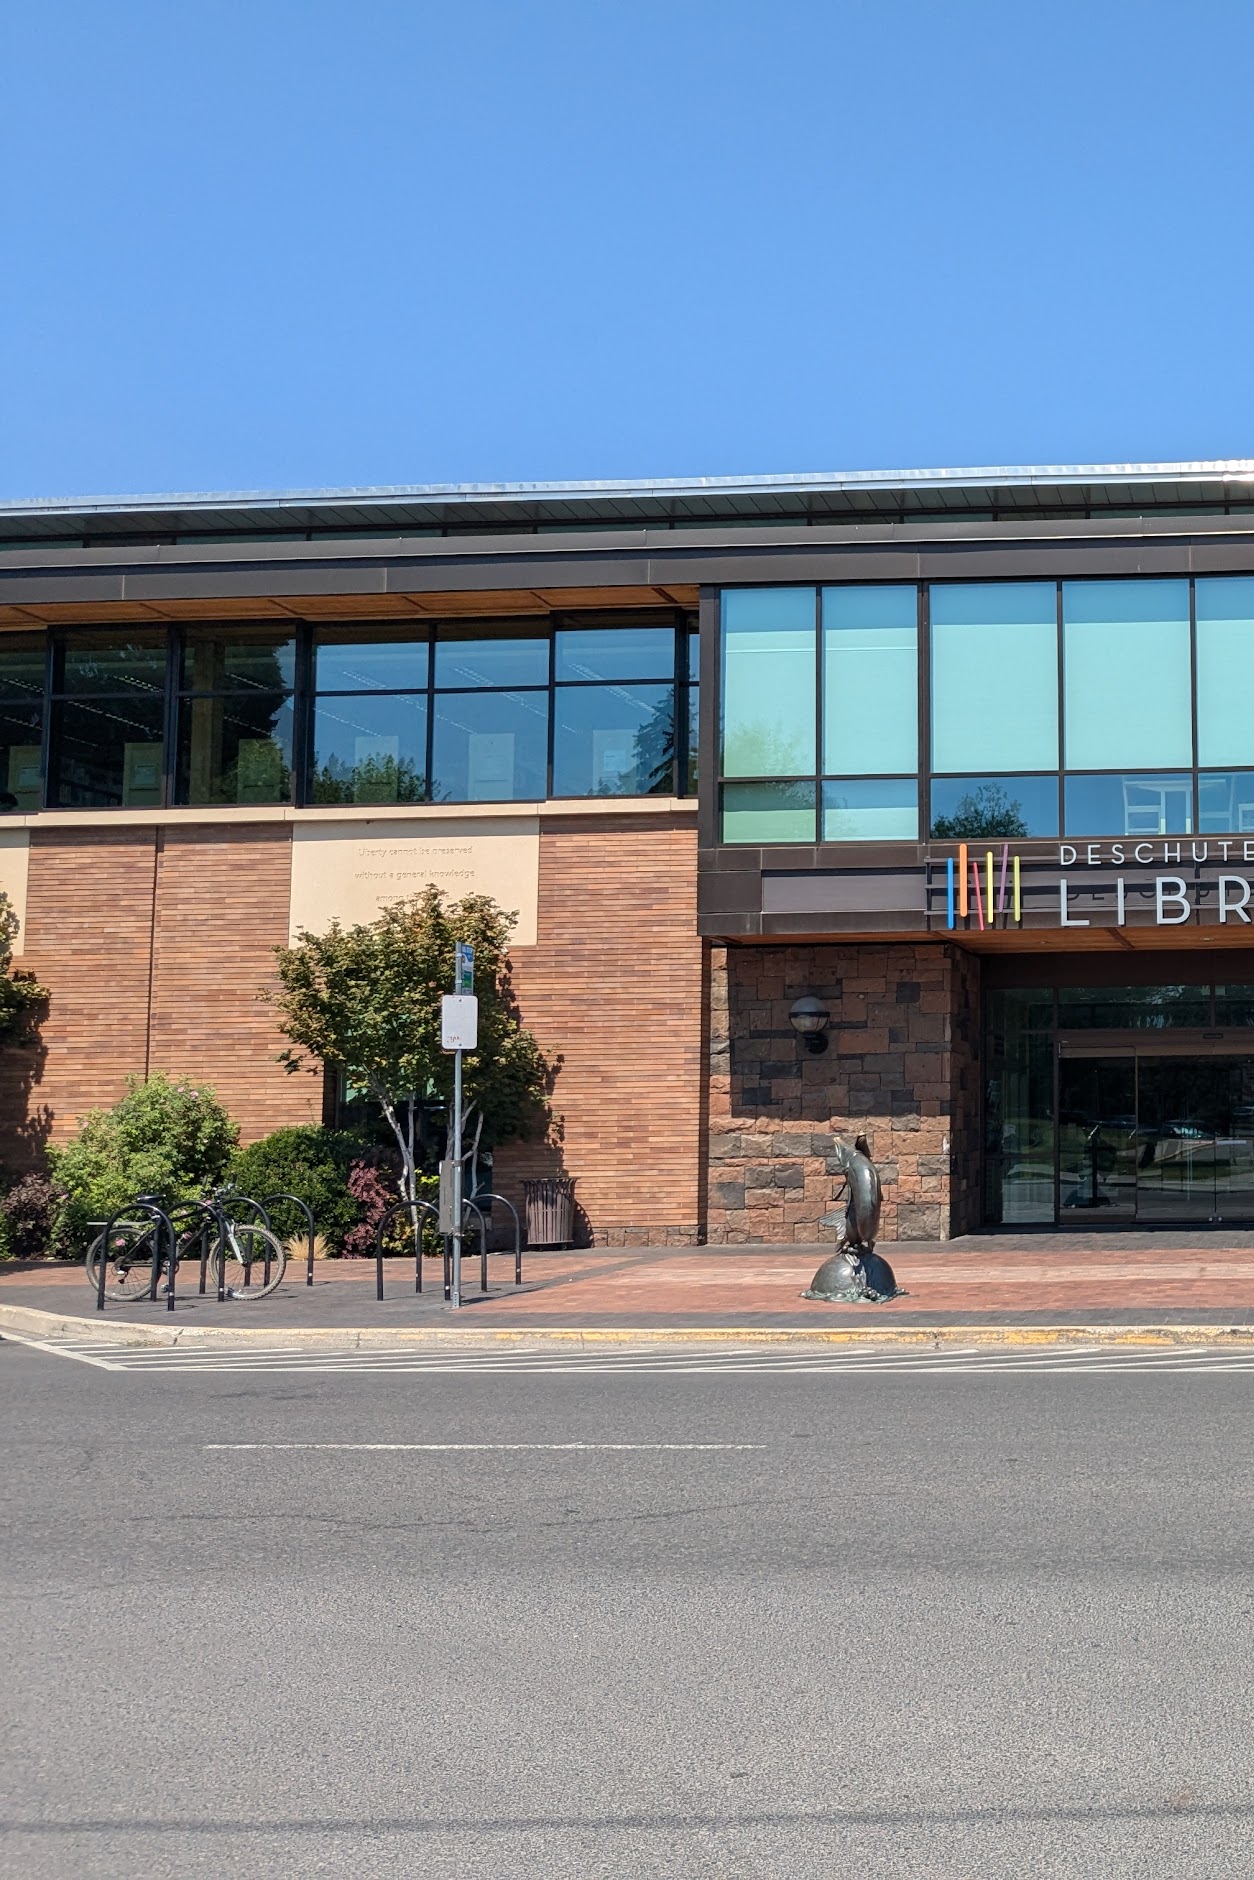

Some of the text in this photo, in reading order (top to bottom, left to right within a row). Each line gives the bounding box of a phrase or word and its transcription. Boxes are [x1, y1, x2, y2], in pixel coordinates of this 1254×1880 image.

[388, 846, 418, 856] cannot
[419, 846, 430, 855] be
[432, 845, 473, 856] preserved
[354, 870, 387, 880] without
[396, 869, 427, 881] general
[429, 868, 475, 880] knowledge
